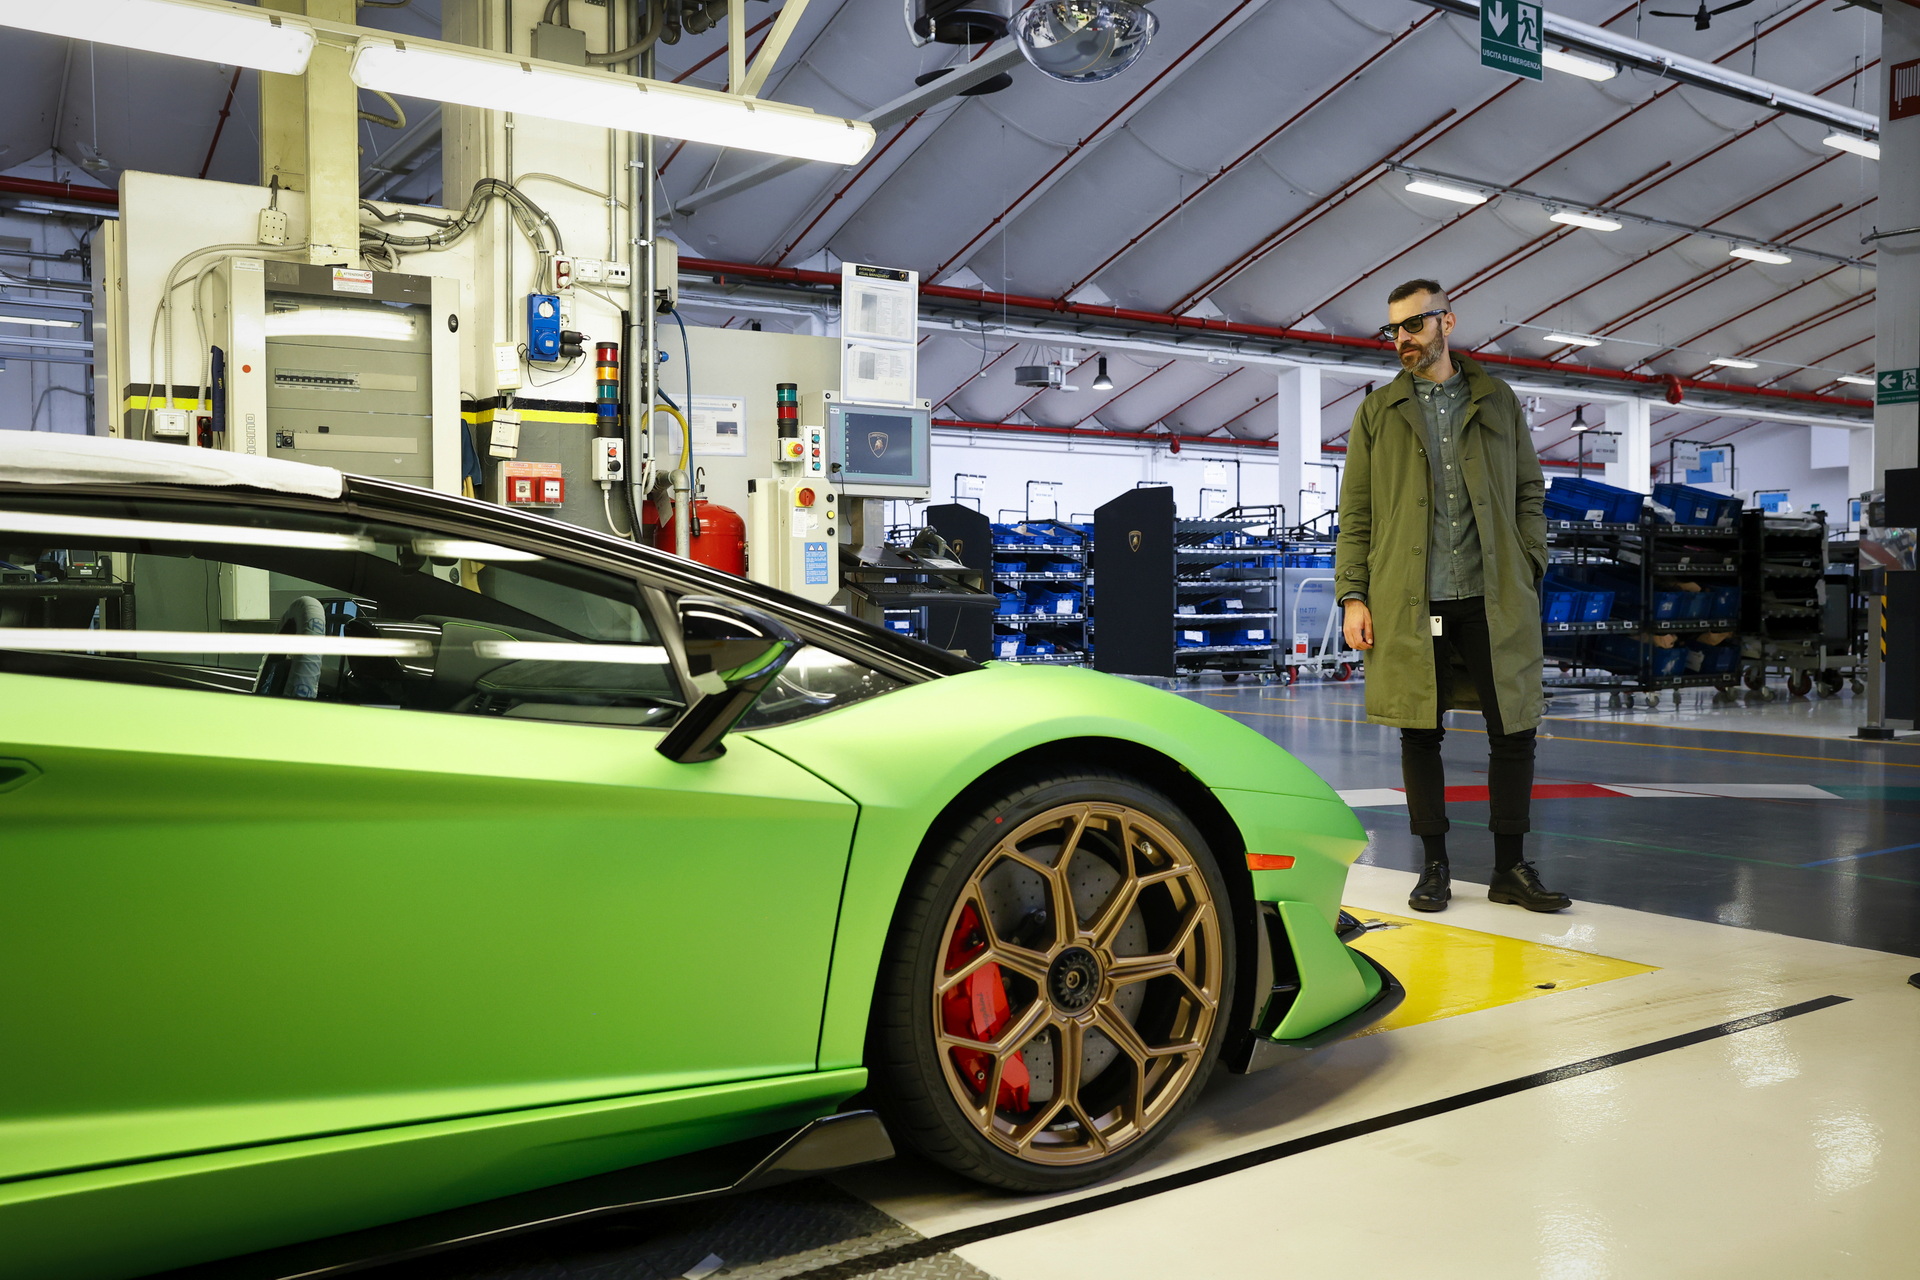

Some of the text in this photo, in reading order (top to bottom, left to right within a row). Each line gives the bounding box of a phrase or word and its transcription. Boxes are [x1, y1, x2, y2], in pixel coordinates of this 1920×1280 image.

[1482, 48, 1541, 70] USCITA DI EMERGENZA
[245, 413, 256, 455] ticino
